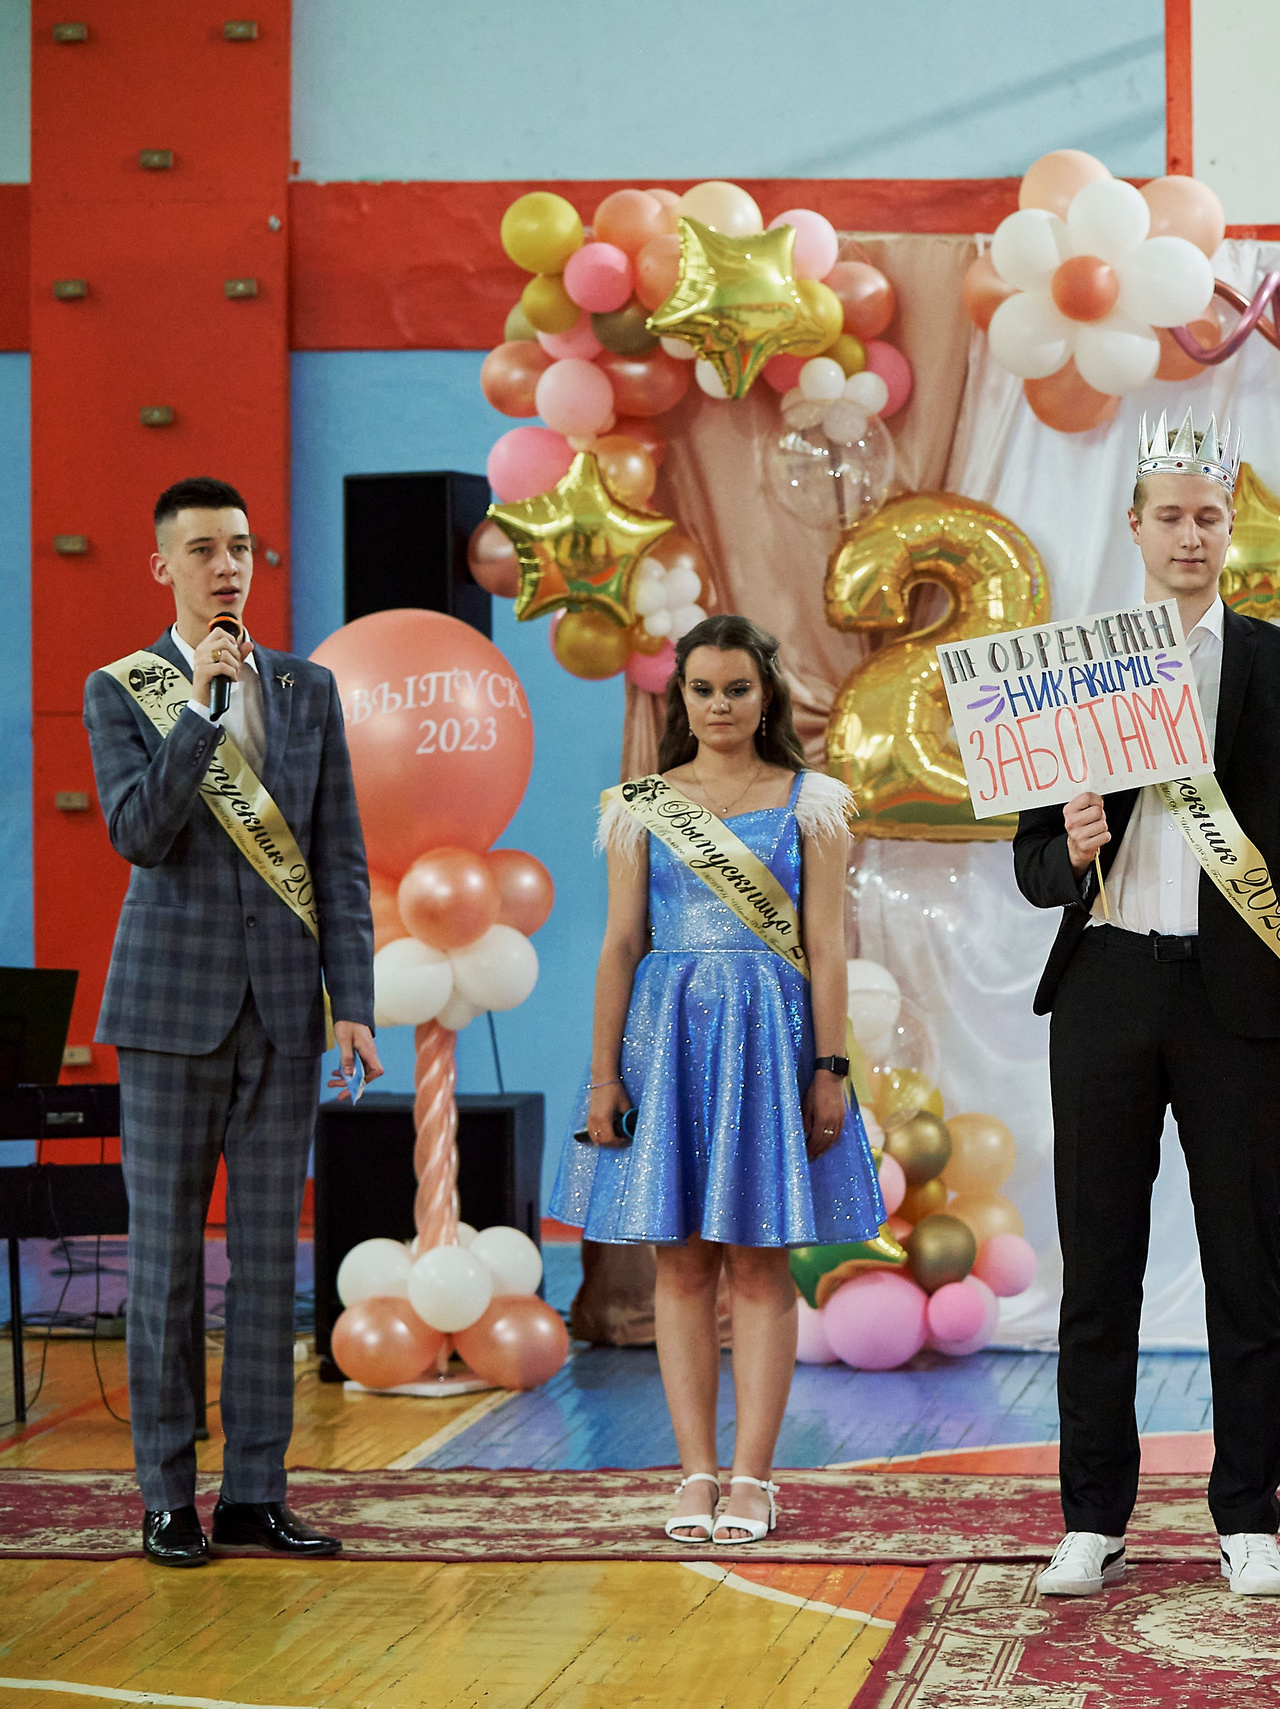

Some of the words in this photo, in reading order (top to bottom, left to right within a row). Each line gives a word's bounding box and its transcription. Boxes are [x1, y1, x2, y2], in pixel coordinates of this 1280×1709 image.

[941, 648, 980, 685] НЕ
[987, 604, 1178, 674] ОБРЕМЕНЁН
[346, 667, 527, 725] ВЫПУСК
[1003, 655, 1159, 717] НИКАКИМИ
[415, 716, 498, 755] 2023
[969, 684, 1209, 801] ЗАБОТАМИ
[657, 800, 792, 936] Выпускница
